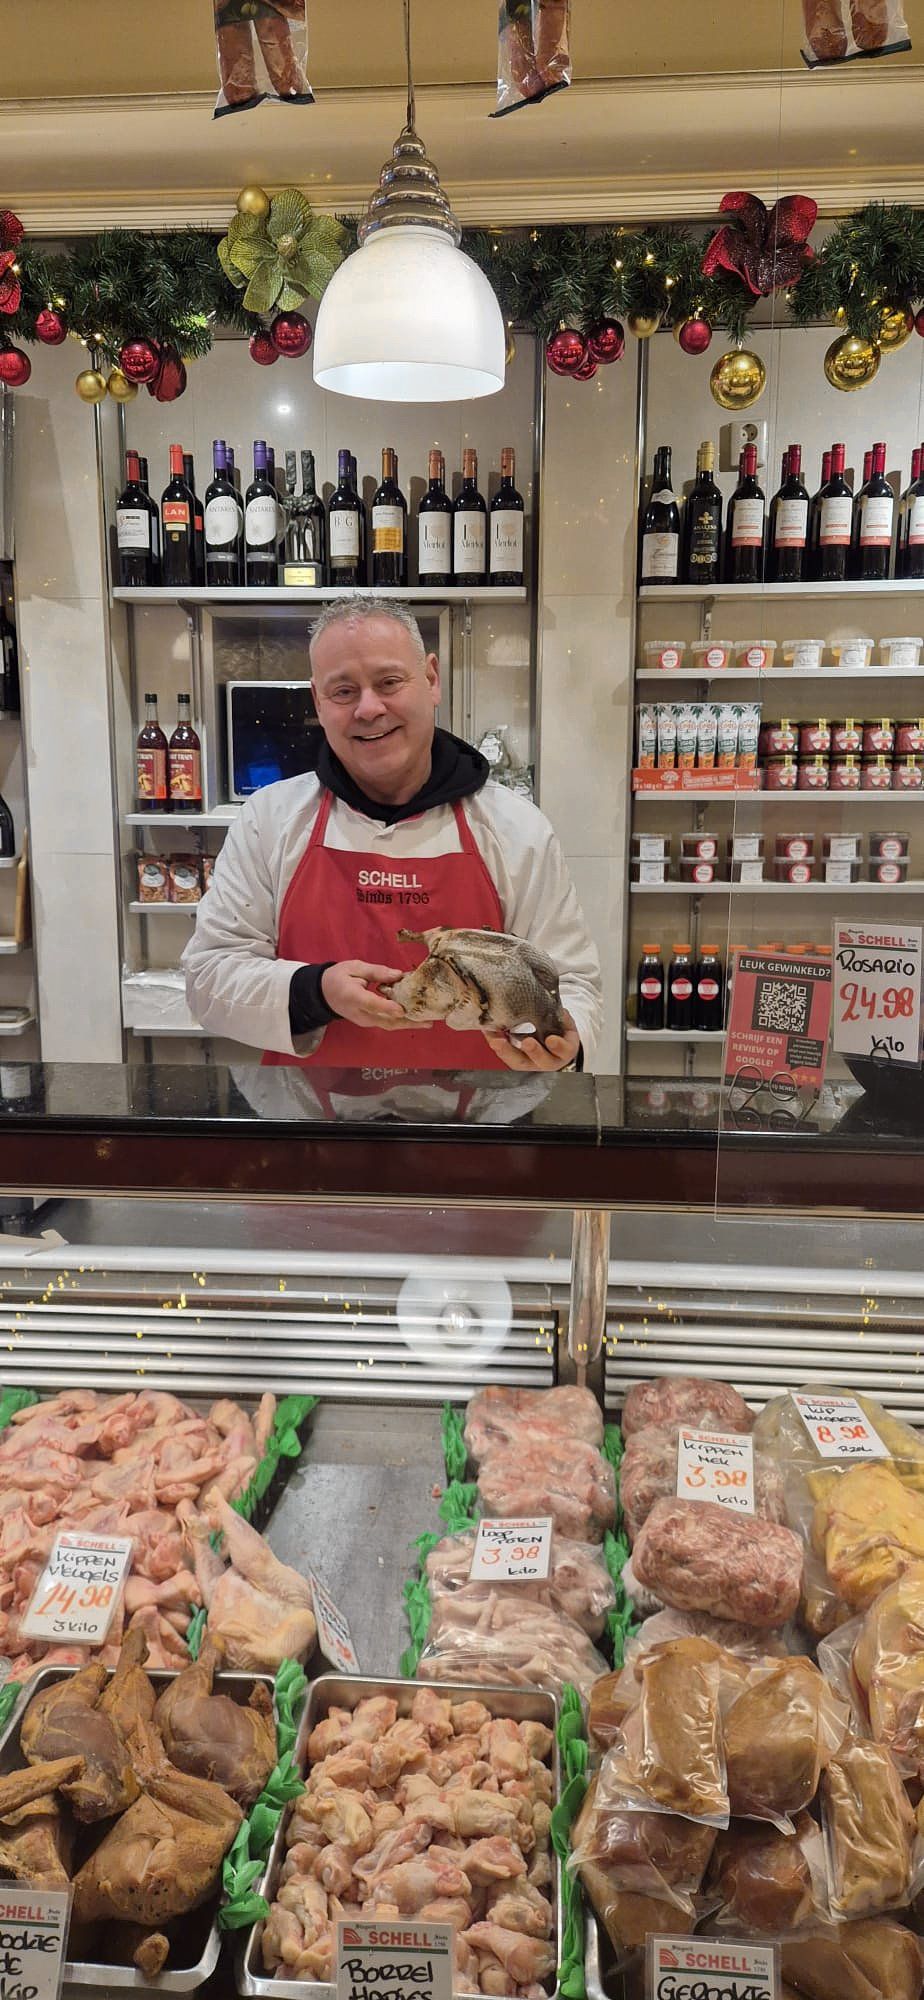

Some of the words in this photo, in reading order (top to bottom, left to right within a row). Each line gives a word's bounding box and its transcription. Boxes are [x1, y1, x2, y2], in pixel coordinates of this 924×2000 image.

[164, 508, 186, 516] LAN
[358, 870, 422, 888] SCHELL
[396, 892, 430, 905] 1796
[858, 934, 906, 947] SCHELL
[740, 959, 765, 970] LEUK
[767, 962, 831, 977] GEWINKELD?
[731, 1032, 763, 1043] SCHRIJF
[766, 1035, 783, 1046] EEN
[732, 1043, 764, 1055] REVIEW
[766, 1047, 779, 1056] OP
[735, 1055, 774, 1068] GOOGLE!
[684, 1464, 747, 1488] 3.98
[481, 1545, 540, 1565] 3.98
[52, 1619, 65, 1633] 3
[369, 1930, 432, 1947] SCHELL
[685, 1953, 751, 1971] SCHELL
